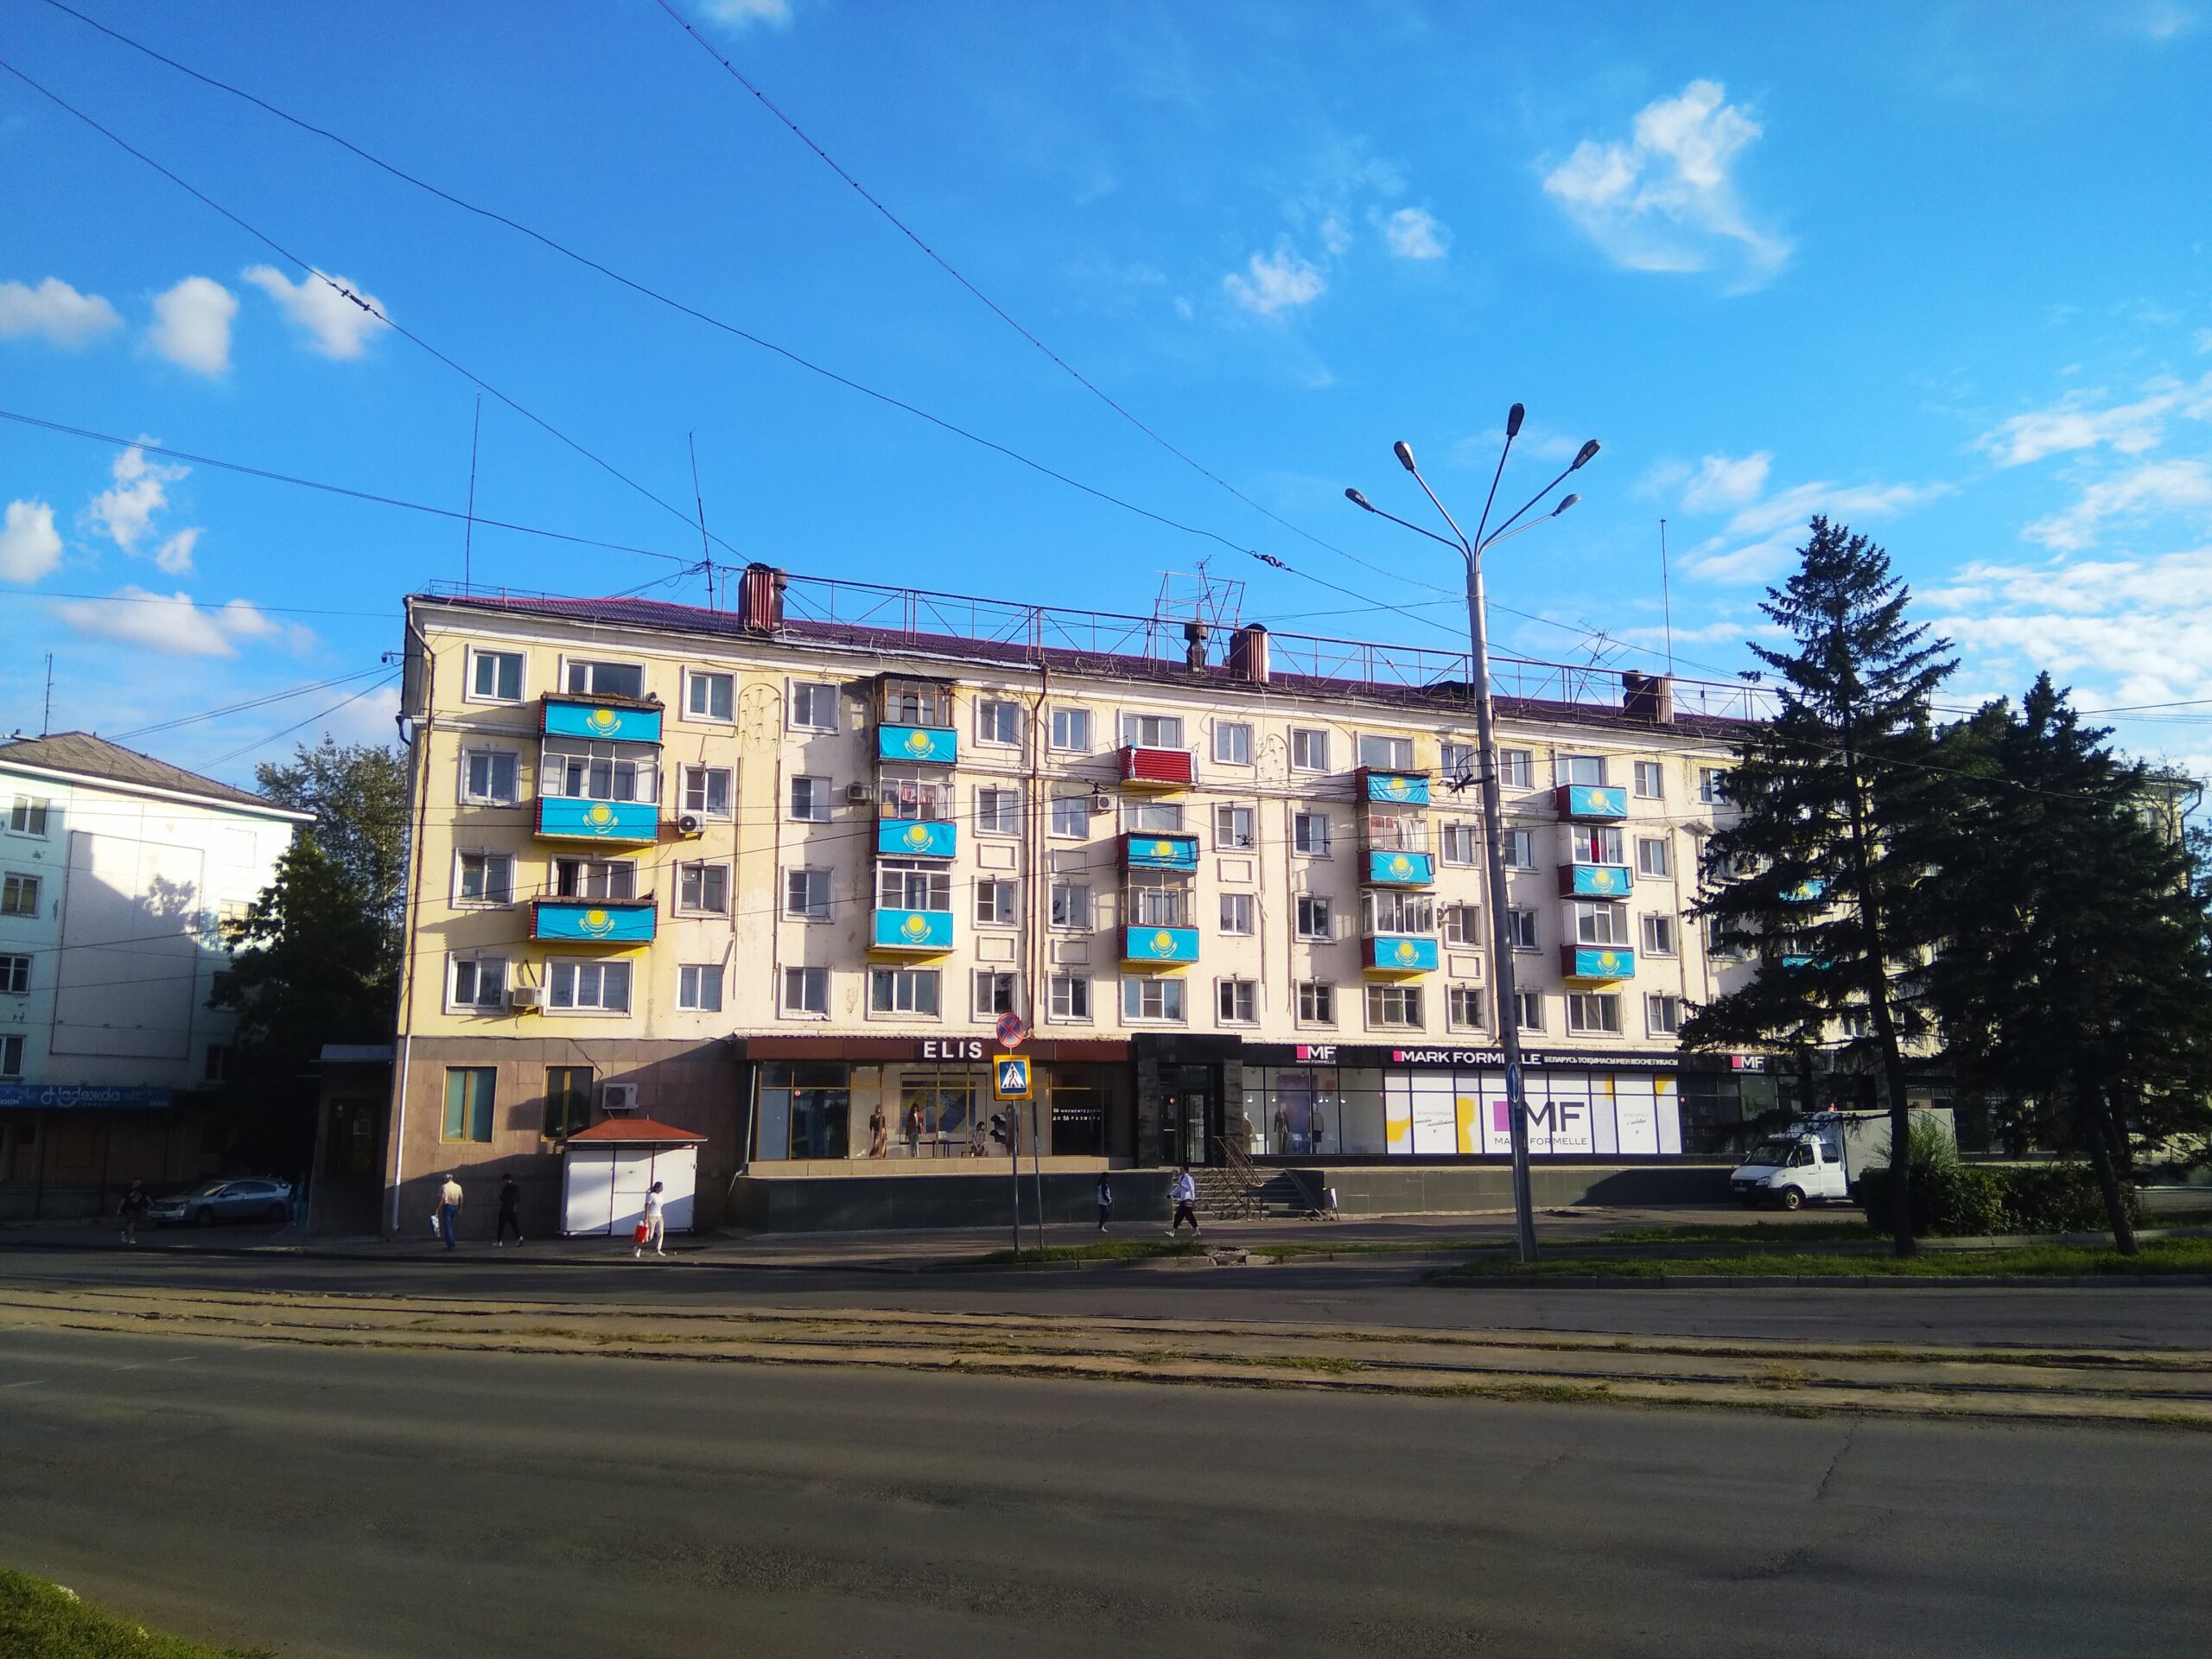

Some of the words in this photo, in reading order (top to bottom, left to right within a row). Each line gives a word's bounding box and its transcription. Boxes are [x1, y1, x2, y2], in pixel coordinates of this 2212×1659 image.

[924, 1041, 982, 1058] ELIS
[1307, 1046, 1337, 1059] MF
[1402, 1051, 1450, 1063] MARK
[1453, 1052, 1541, 1065] FORMLE
[1741, 1056, 1764, 1068] MF
